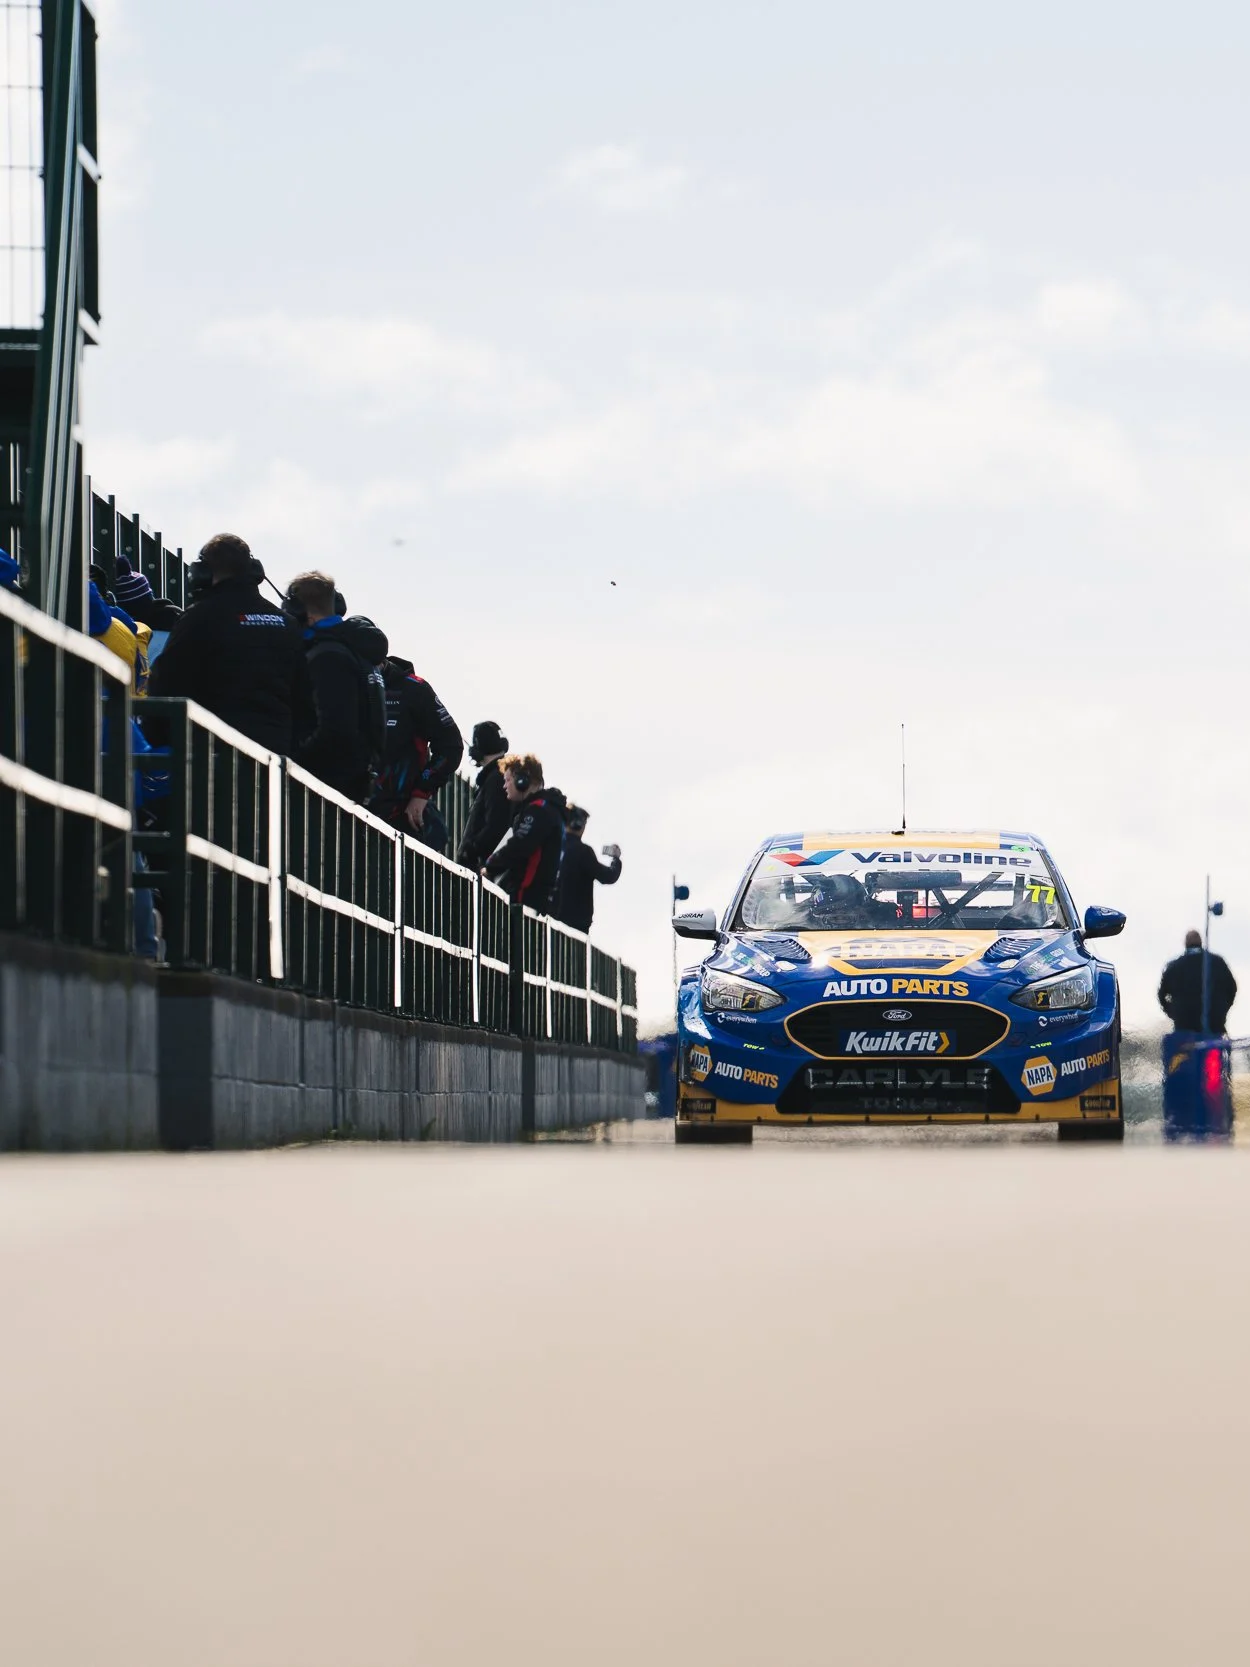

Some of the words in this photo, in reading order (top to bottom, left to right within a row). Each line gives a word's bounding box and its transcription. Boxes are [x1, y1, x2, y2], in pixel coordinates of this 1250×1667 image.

[851, 851, 1032, 868] Valvoline
[1026, 884, 1056, 905] 77
[823, 978, 888, 998] AUTO
[891, 978, 969, 997] PARTS
[886, 1010, 908, 1020] Ford
[1049, 1013, 1079, 1023] everywhen
[1061, 1057, 1086, 1076] AUTO
[1086, 1049, 1110, 1069] PARTS
[714, 1061, 743, 1080] AUTO
[743, 1068, 779, 1089] PARTS
[804, 1067, 992, 1089] CARLYLE
[1026, 1066, 1054, 1086] NAPA
